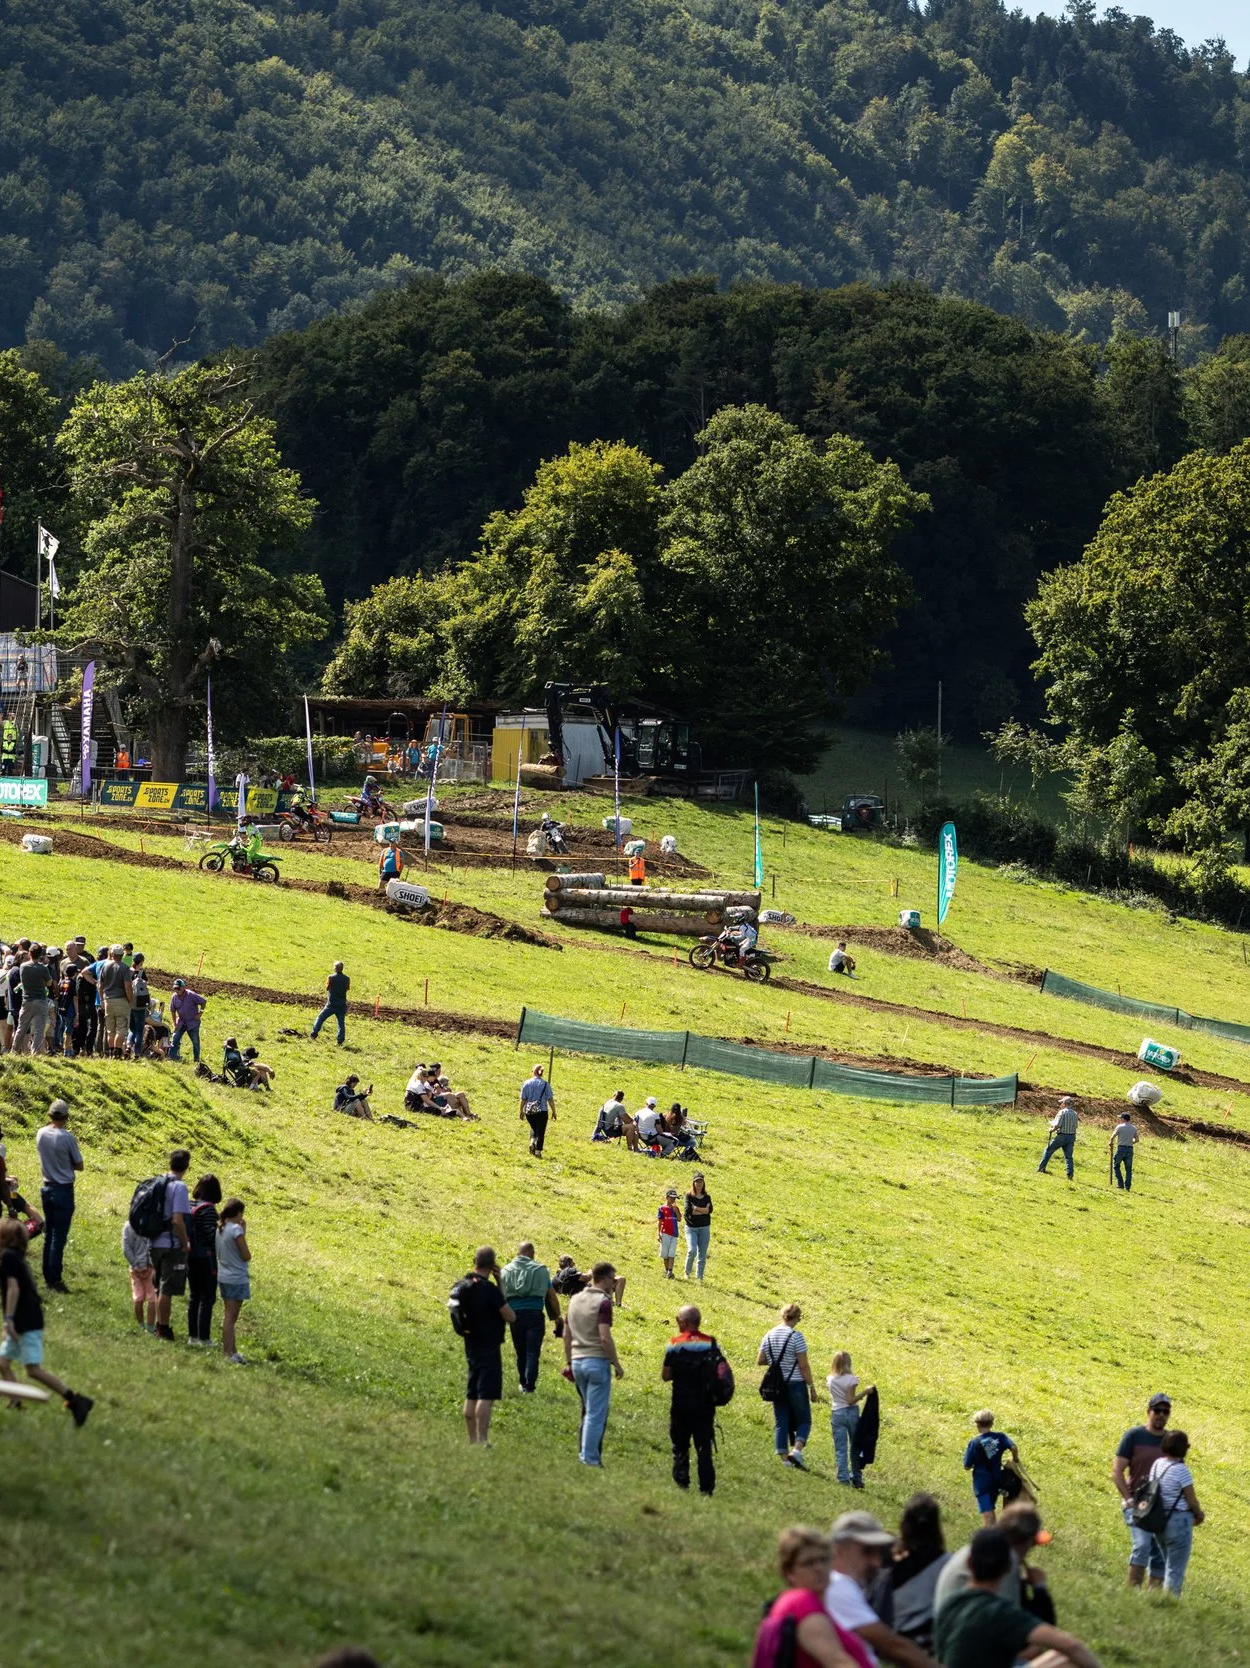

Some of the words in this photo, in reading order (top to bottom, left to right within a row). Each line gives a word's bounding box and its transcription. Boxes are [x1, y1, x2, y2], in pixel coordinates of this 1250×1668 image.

[82, 689, 92, 743] YAMAHA
[143, 787, 169, 796] SPORTS
[398, 890, 423, 904] SHOEI
